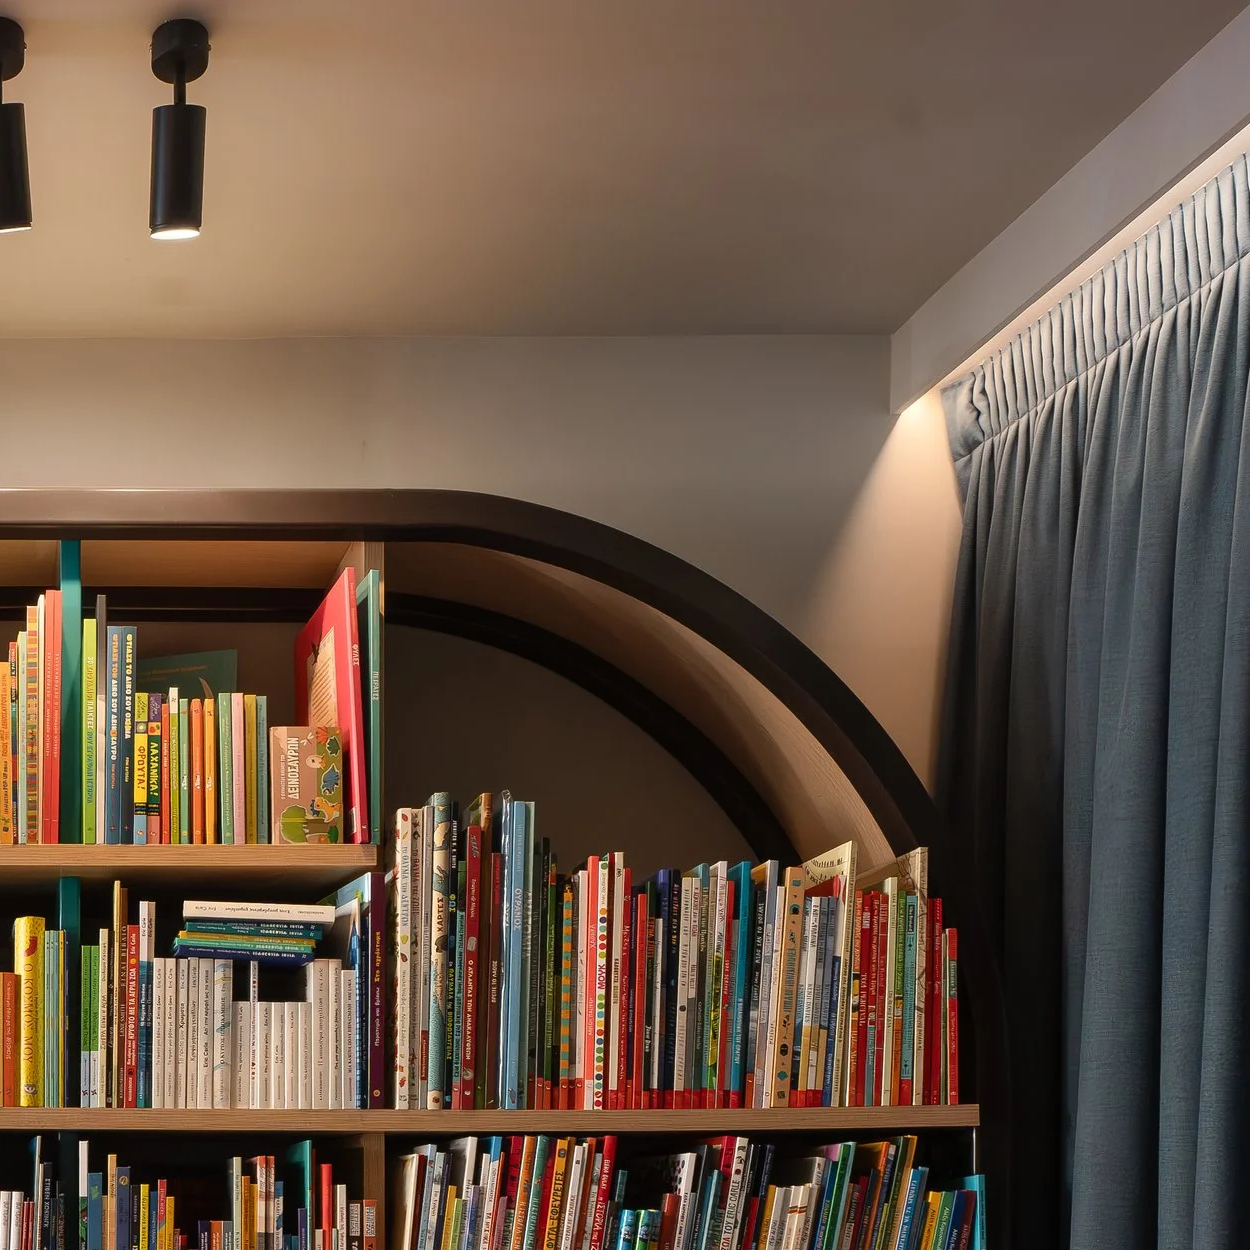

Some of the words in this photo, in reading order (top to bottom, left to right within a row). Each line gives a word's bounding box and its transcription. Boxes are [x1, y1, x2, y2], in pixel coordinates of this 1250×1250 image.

[150, 743, 159, 797] ΛΑΧΑΝΙΚΑ!
[287, 737, 300, 800] ΔΕΙΝΟΣΑΥΡΩΝ
[437, 898, 445, 932] ΧΑΡΤΕΣ
[514, 888, 522, 931] ΟΥΡΑΝΟΣ
[128, 968, 137, 980] ΖΩΑ
[598, 964, 607, 990] ΜΟΥΚ
[128, 981, 137, 997] ΑΓΡΙΑ
[24, 978, 33, 1030] ΚΟΣΜΟΣ
[128, 998, 137, 1006] ΤΑ
[128, 1006, 137, 1016] ΜΕ
[128, 1016, 137, 1040] ΚΡΥΦΤΟ
[24, 1036, 33, 1063] ΜΟΥ
[728, 1180, 740, 1203] CARLE
[726, 1204, 737, 1220] ERIC
[723, 1221, 732, 1236] ΤΟΥ
